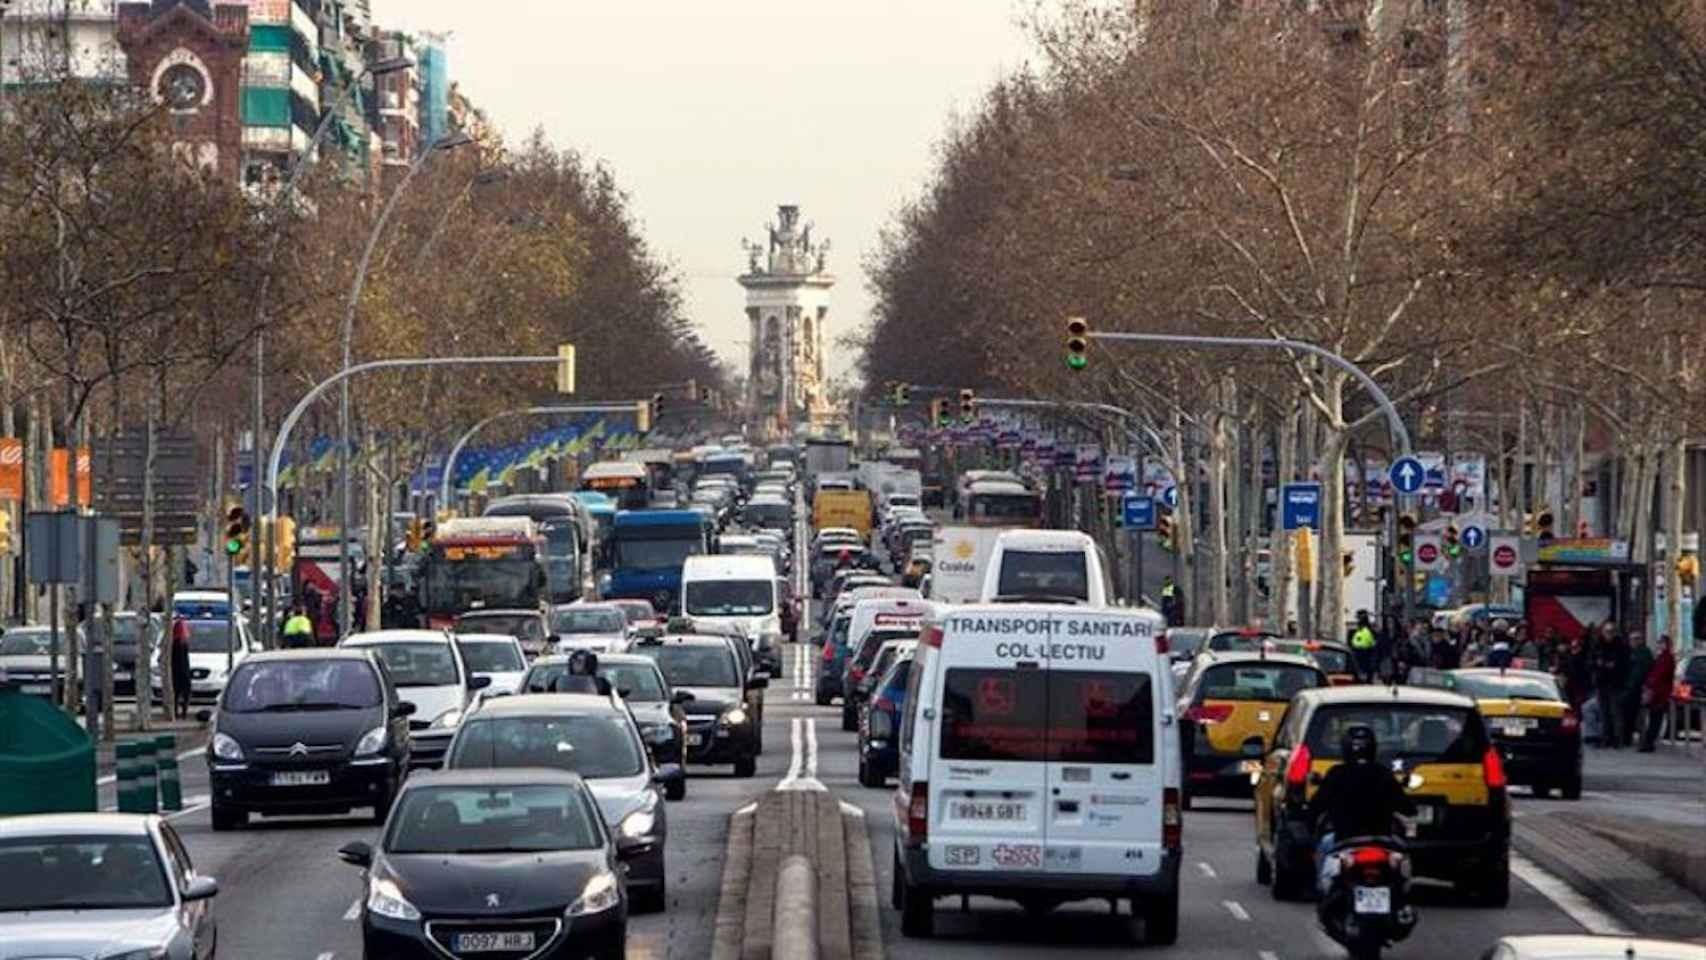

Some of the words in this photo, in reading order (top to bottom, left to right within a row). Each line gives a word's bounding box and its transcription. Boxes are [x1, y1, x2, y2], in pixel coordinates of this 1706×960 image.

[951, 618, 1061, 635] TRANSPORT
[1067, 620, 1153, 637] SANITARI
[996, 643, 1105, 660] COL·LECTIU
[462, 933, 496, 950] 0097
